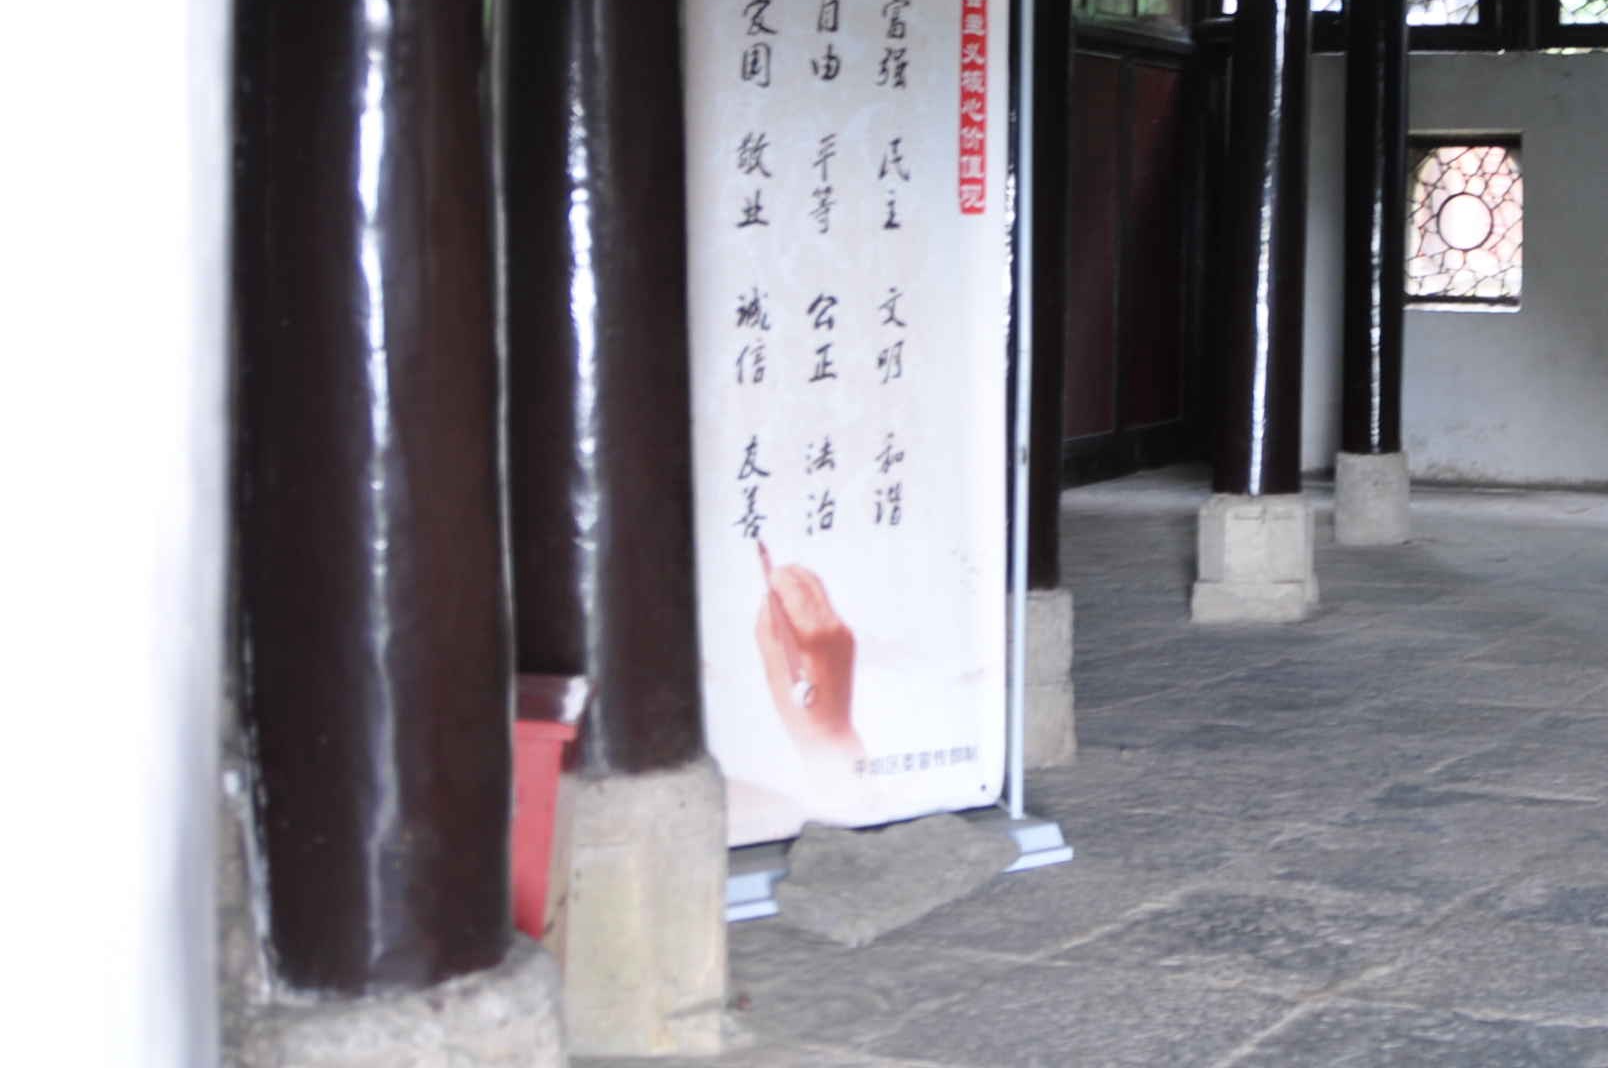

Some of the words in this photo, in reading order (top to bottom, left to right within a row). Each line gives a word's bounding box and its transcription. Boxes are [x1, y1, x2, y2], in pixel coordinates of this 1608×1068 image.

[735, 132, 773, 230] 敬业
[809, 133, 839, 235] 平等
[877, 137, 911, 231] 民主
[735, 287, 772, 386] 诚信
[806, 292, 840, 385] 公正
[876, 286, 909, 385] 文明
[735, 435, 772, 539] 友善
[805, 435, 836, 536] 法治
[874, 433, 906, 528] 和谐
